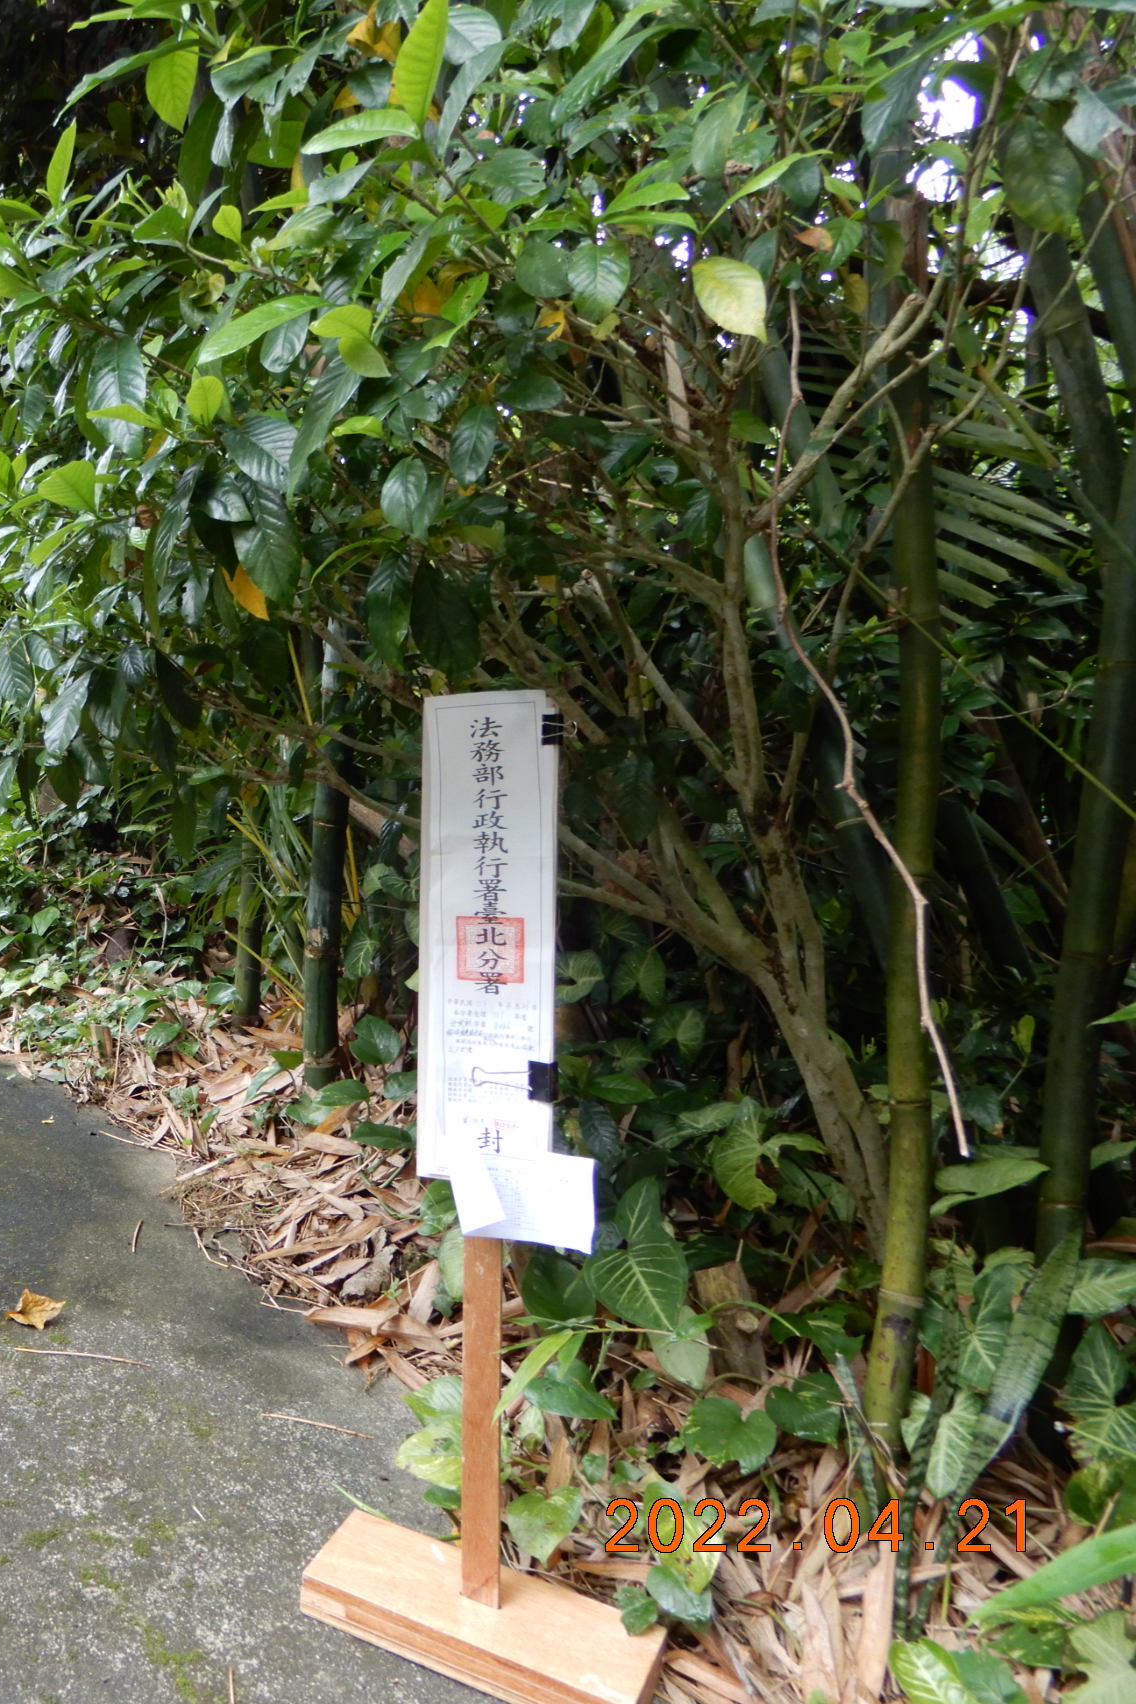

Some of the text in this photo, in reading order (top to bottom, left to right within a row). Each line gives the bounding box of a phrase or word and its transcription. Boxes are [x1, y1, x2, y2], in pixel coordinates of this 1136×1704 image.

[469, 716, 509, 996] 法務部行政執行署臺北分署
[477, 1127, 503, 1154] 封
